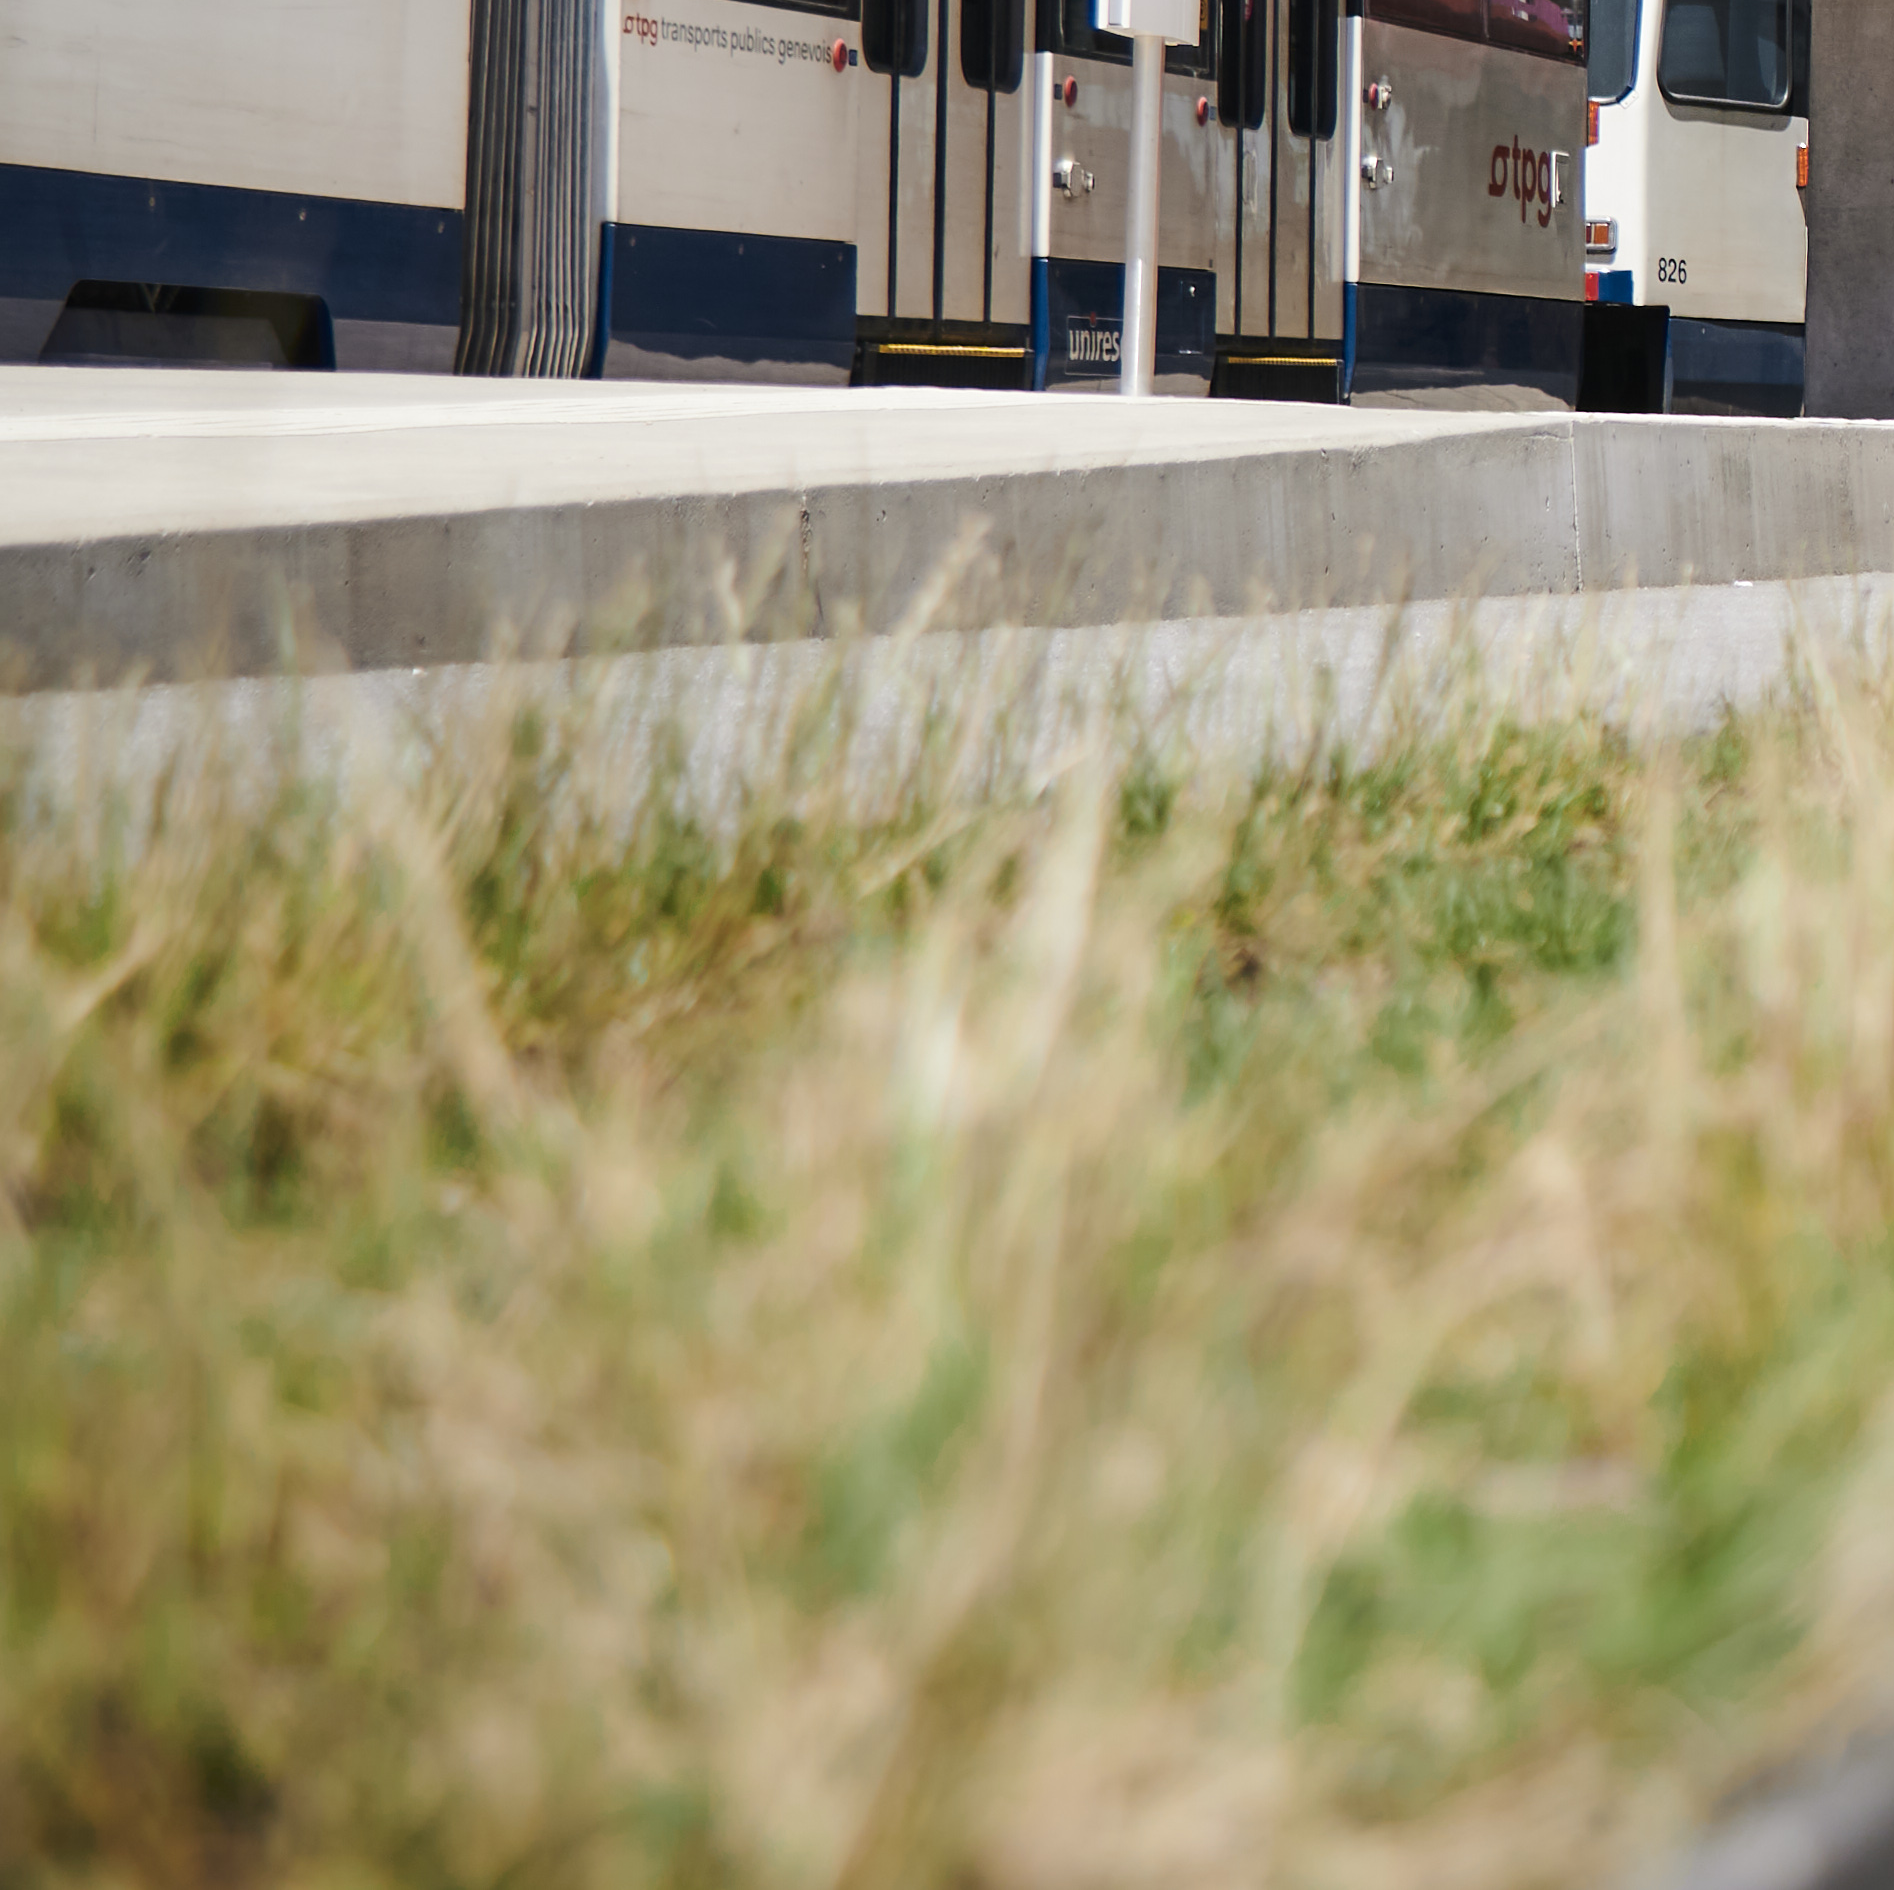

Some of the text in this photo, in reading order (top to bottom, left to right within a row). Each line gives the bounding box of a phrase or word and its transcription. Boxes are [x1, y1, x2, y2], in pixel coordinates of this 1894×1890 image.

[661, 17, 728, 52] transports
[730, 26, 776, 58] publics
[777, 39, 832, 65] genevois
[1512, 134, 1552, 228] tpg
[1658, 257, 1687, 284] 826
[1069, 329, 1121, 362] unires
